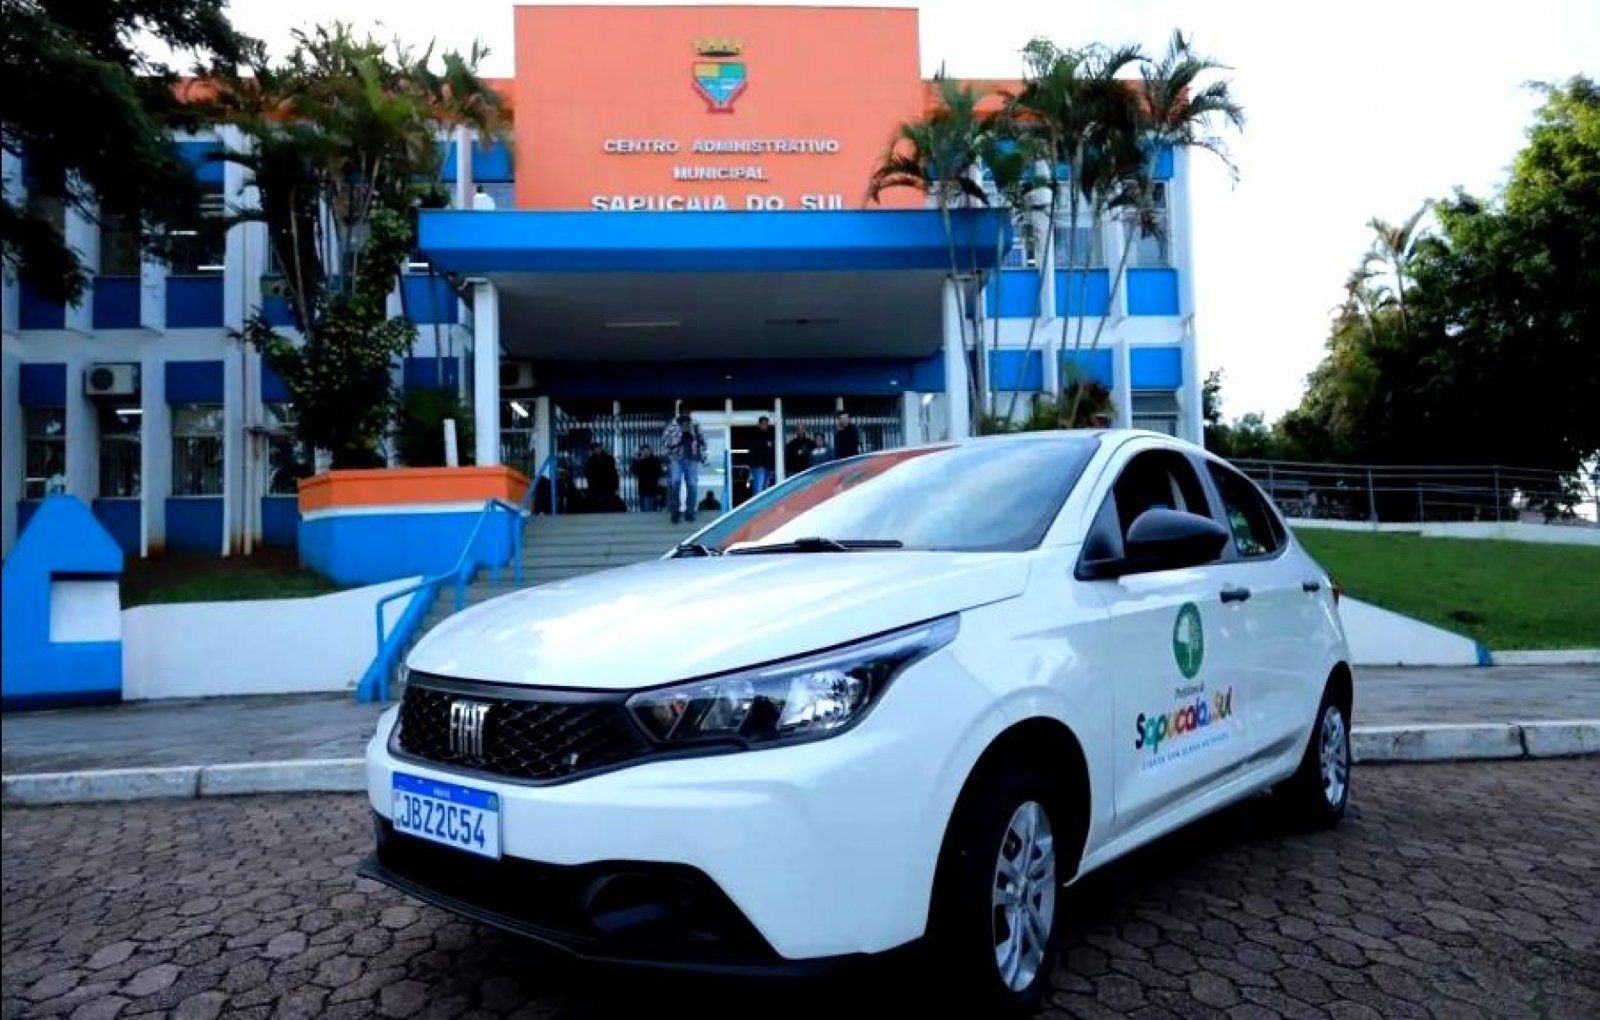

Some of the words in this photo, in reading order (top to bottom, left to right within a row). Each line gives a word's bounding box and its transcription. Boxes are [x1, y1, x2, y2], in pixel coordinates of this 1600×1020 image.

[604, 138, 680, 154] CENTRO
[692, 138, 840, 154] ADMINISTRATIVO
[673, 165, 768, 181] MUNICIPAL
[591, 194, 728, 211] SAPUCAIA
[745, 194, 784, 211] DO
[450, 701, 491, 758] FIAT
[400, 794, 486, 849] JBZ2C54
